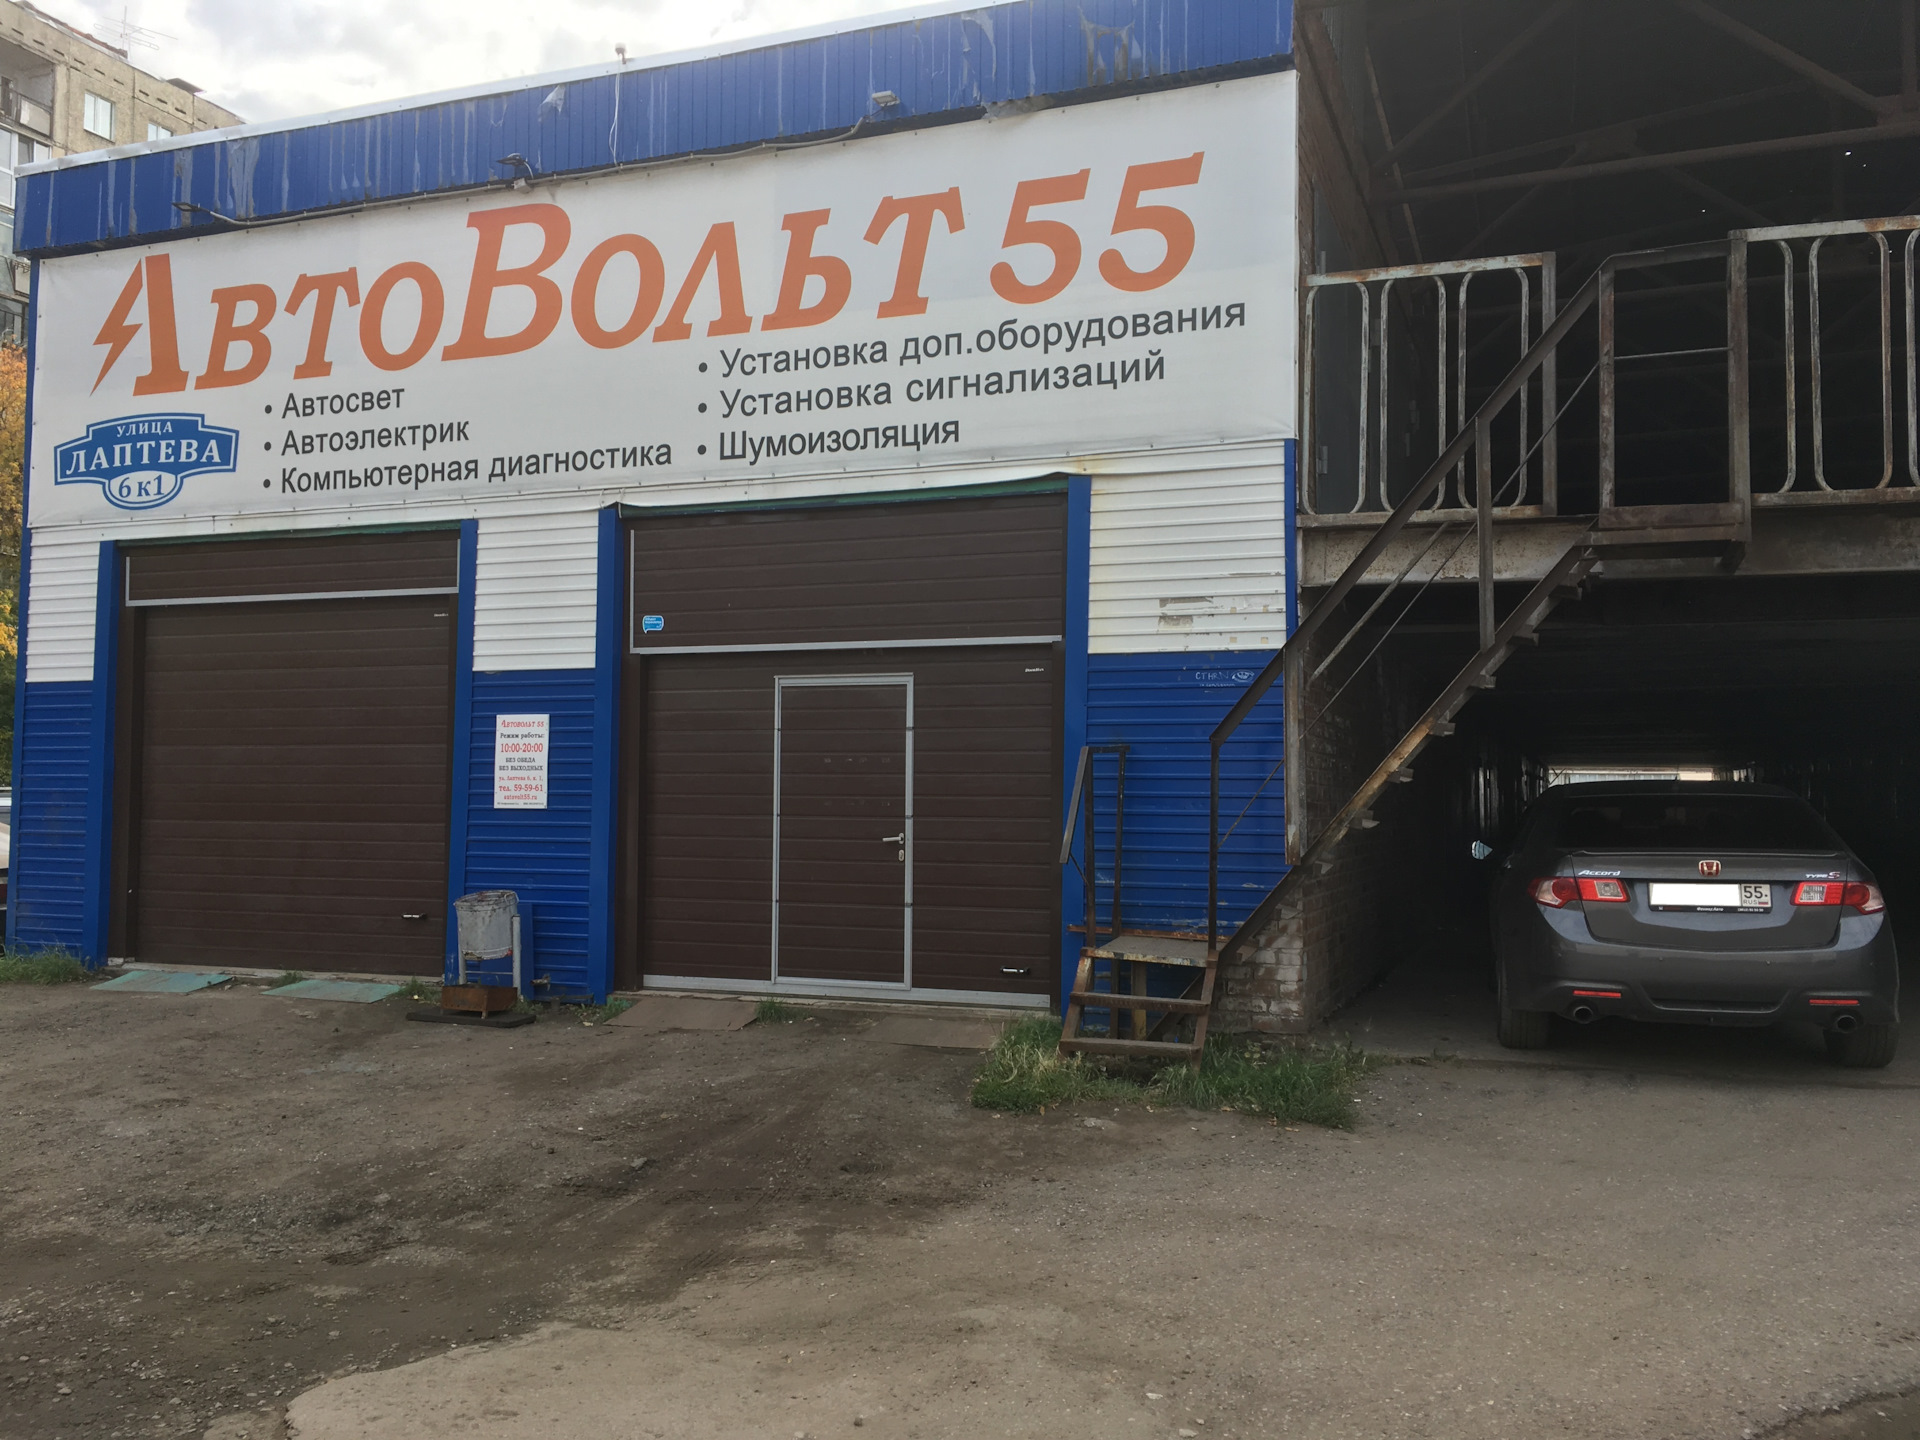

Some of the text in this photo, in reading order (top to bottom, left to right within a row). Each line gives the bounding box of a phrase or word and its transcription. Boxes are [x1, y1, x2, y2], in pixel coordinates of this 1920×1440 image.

[990, 152, 1204, 305] 55
[720, 302, 1245, 378] Установка доп.оборудования
[720, 348, 1165, 419] Установка сигнализаций
[282, 388, 405, 419] Автосвет
[116, 421, 173, 438] УЛИЦА
[281, 420, 470, 457] Автоэлектрик
[720, 420, 960, 465] Шумоизоляция
[65, 439, 222, 475] ЛАПТЕВА
[281, 441, 673, 494] Компьютерная диагностика
[118, 477, 132, 498] 6
[501, 743, 544, 753] 10:00-20:00
[520, 732, 545, 740] работы:
[513, 784, 543, 792] 59-59-61
[1828, 871, 1841, 879] S
[1743, 885, 1764, 899] 55
